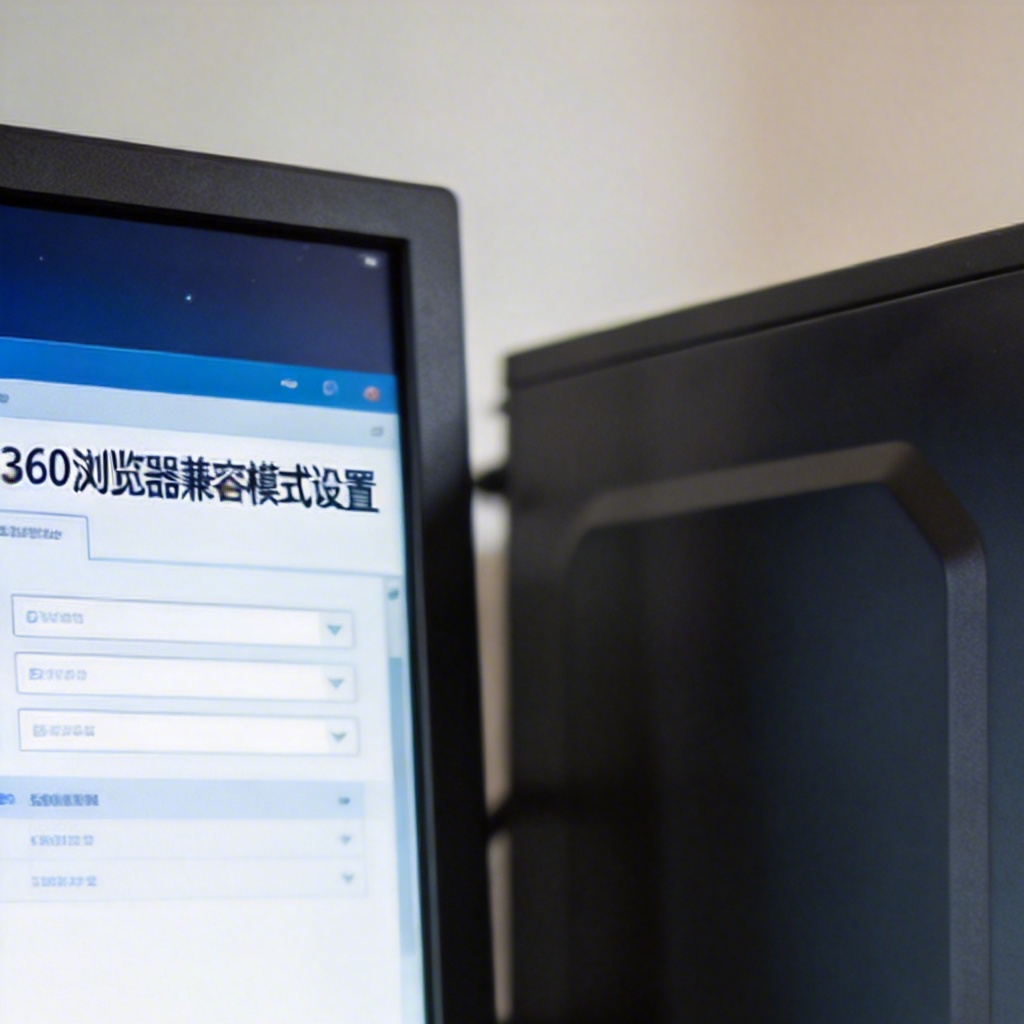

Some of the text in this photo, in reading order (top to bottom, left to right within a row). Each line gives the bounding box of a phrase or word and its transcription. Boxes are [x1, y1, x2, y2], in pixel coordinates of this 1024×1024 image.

[1, 446, 379, 513] 360浏览器兼容模式设置
